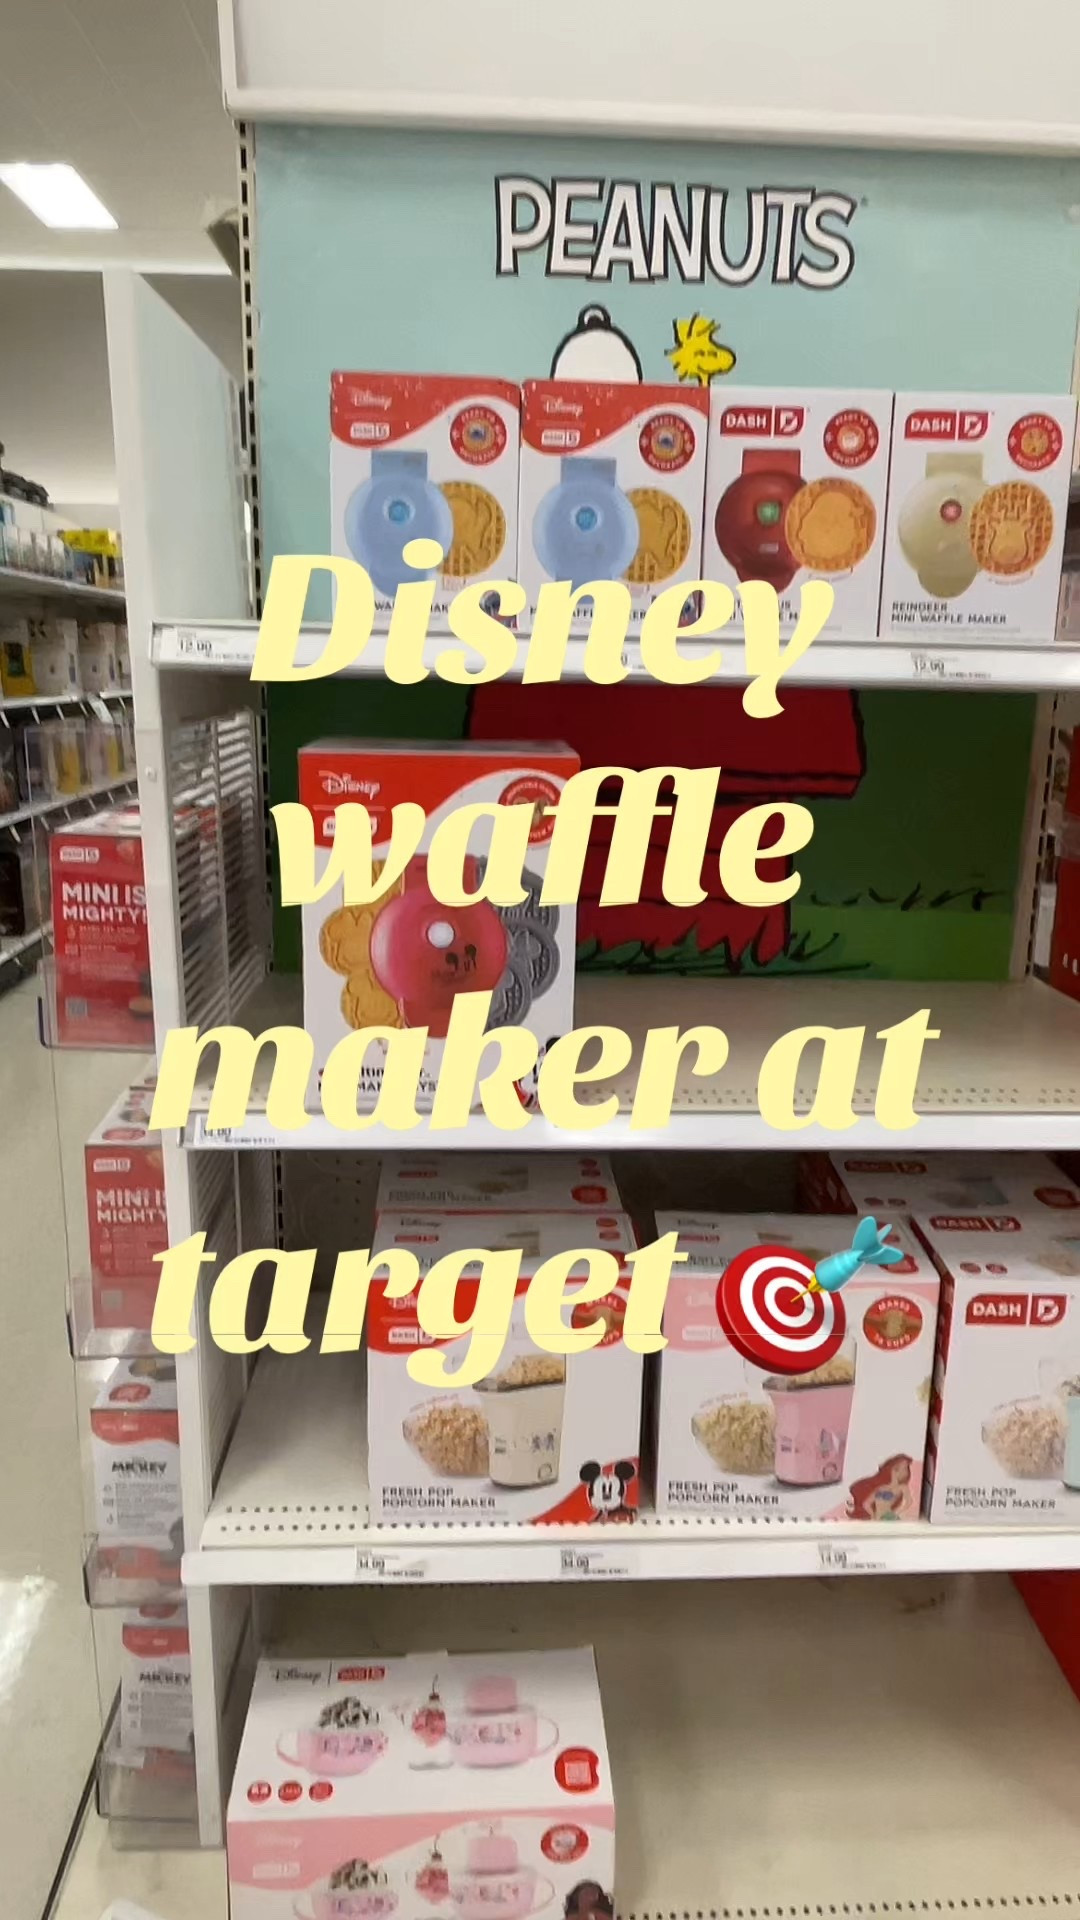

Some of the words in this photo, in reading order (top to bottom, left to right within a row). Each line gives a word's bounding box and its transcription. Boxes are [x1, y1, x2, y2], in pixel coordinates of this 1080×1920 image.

[494, 174, 858, 289] PEANUTS
[725, 413, 767, 428] DASH
[910, 418, 951, 432] DASH
[892, 602, 947, 611] REINDEER
[891, 614, 915, 622] MINI
[919, 614, 963, 624] WAFFLE
[968, 615, 1006, 624] MAKER
[318, 770, 380, 800] Disney
[62, 883, 118, 905] MINI
[96, 1188, 152, 1207] MINI
[972, 1302, 1021, 1317] DASH
[381, 1486, 423, 1497] FRESH
[428, 1487, 454, 1497] POP
[667, 1480, 709, 1492] FRESH
[713, 1482, 739, 1493] POP
[946, 1487, 986, 1497] FRESH
[992, 1487, 1017, 1498] POP
[381, 1498, 446, 1508] POPCORN
[450, 1498, 496, 1508] MAKER
[667, 1493, 731, 1504] POPCORN
[735, 1494, 780, 1505] MAKER
[945, 1498, 1008, 1509] POPCORN
[1012, 1499, 1056, 1509] MAKER
